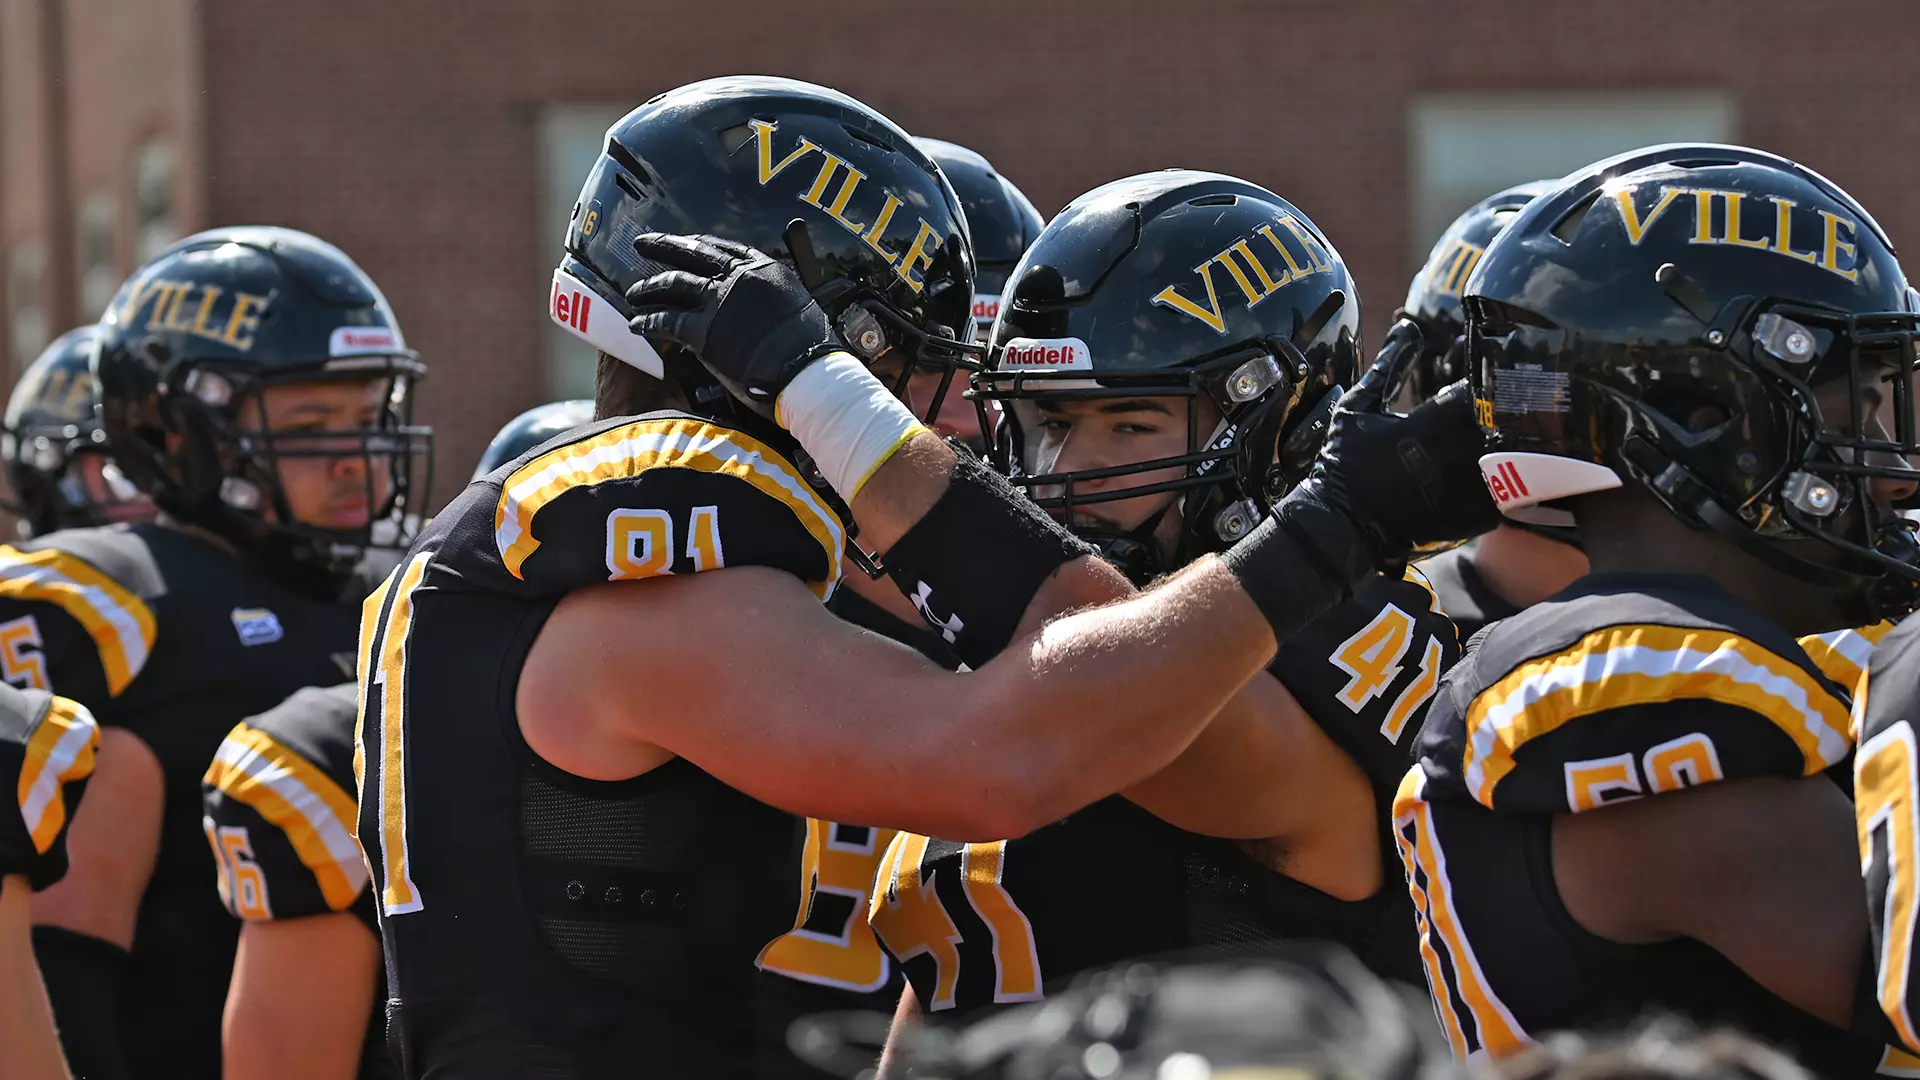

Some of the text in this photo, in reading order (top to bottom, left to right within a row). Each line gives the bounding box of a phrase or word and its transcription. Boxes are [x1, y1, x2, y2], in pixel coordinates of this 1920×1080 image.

[579, 208, 598, 236] 16
[747, 117, 944, 294] VILLE
[1616, 187, 1861, 282] VILLE
[1151, 215, 1333, 335] VILLE
[119, 279, 277, 350] VILLE
[1005, 344, 1074, 365] Riddell
[1475, 398, 1494, 429] 78
[605, 505, 725, 581] 81
[1328, 602, 1443, 745] 41
